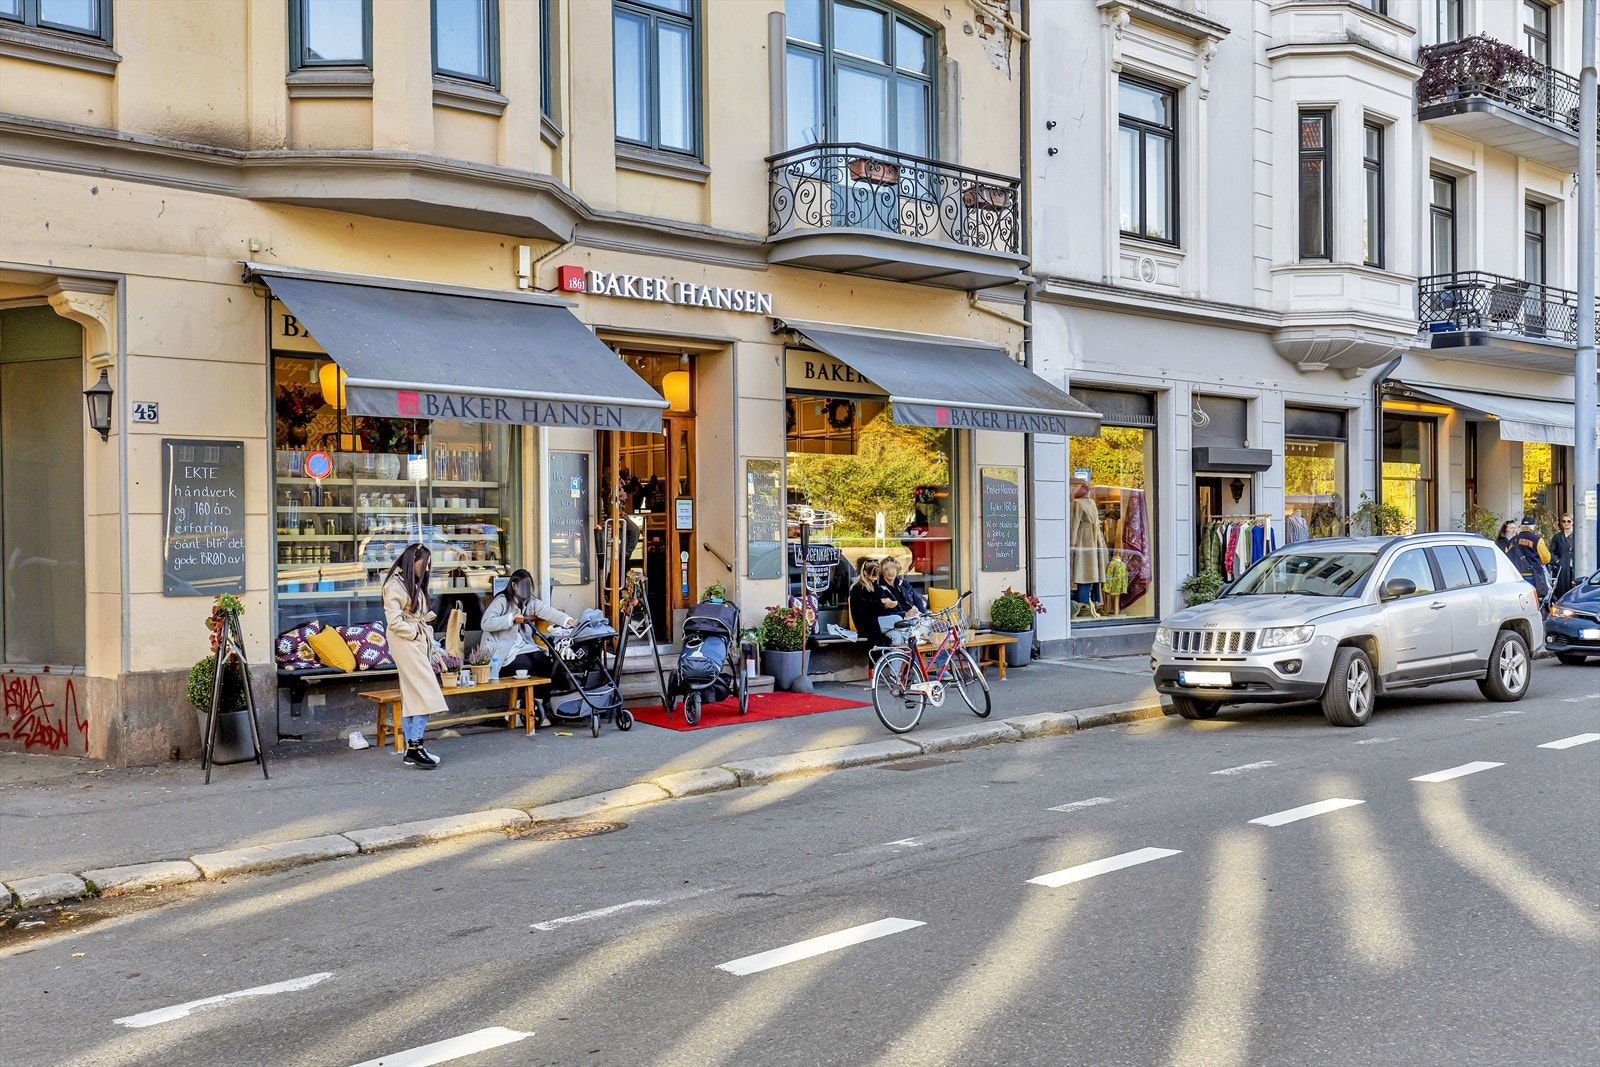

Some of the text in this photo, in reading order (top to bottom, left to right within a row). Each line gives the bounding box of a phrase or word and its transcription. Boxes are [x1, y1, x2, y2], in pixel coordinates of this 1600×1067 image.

[569, 278, 585, 290] 1861
[590, 270, 773, 314] BAKER HANSEN
[281, 314, 309, 337] B
[134, 404, 157, 420] 45
[426, 393, 623, 428] BAKER HANSEN
[951, 409, 1001, 429] BAKER
[1006, 413, 1067, 433] HANSEN
[184, 466, 218, 479] EKTE
[174, 485, 237, 498] håndverk
[174, 502, 232, 521] og 160 års
[175, 522, 229, 540] erfaring
[206, 539, 223, 549] blir
[228, 539, 244, 549] det
[174, 556, 199, 571] gode
[200, 551, 226, 565] BRØD
